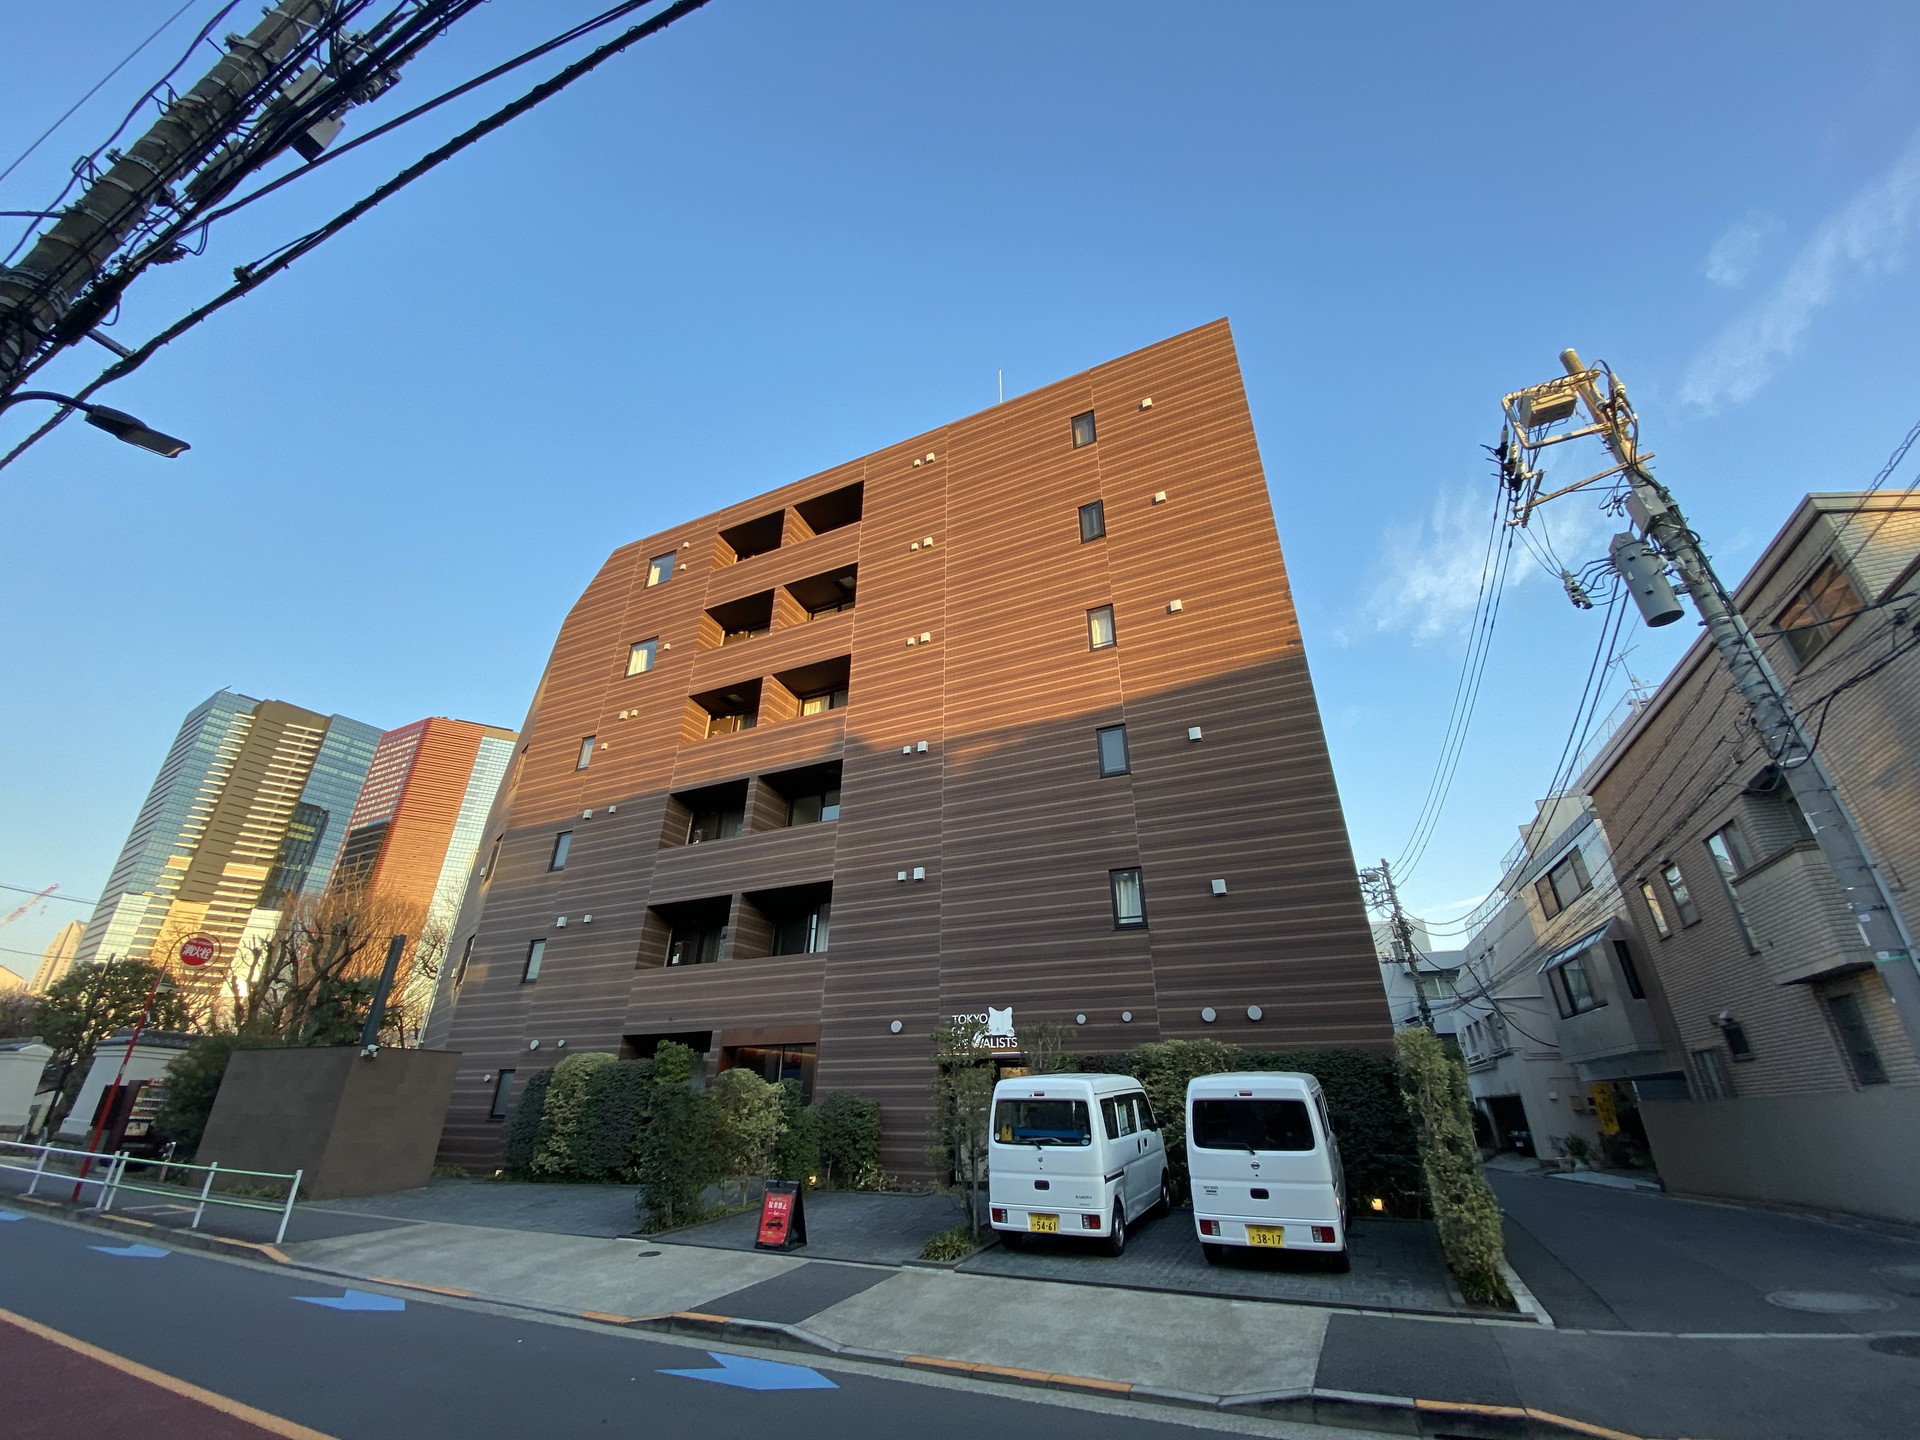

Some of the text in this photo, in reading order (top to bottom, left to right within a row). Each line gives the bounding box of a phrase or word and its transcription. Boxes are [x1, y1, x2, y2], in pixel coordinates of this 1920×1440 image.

[182, 943, 212, 960] 消火栓
[951, 1013, 988, 1025] TOKYO
